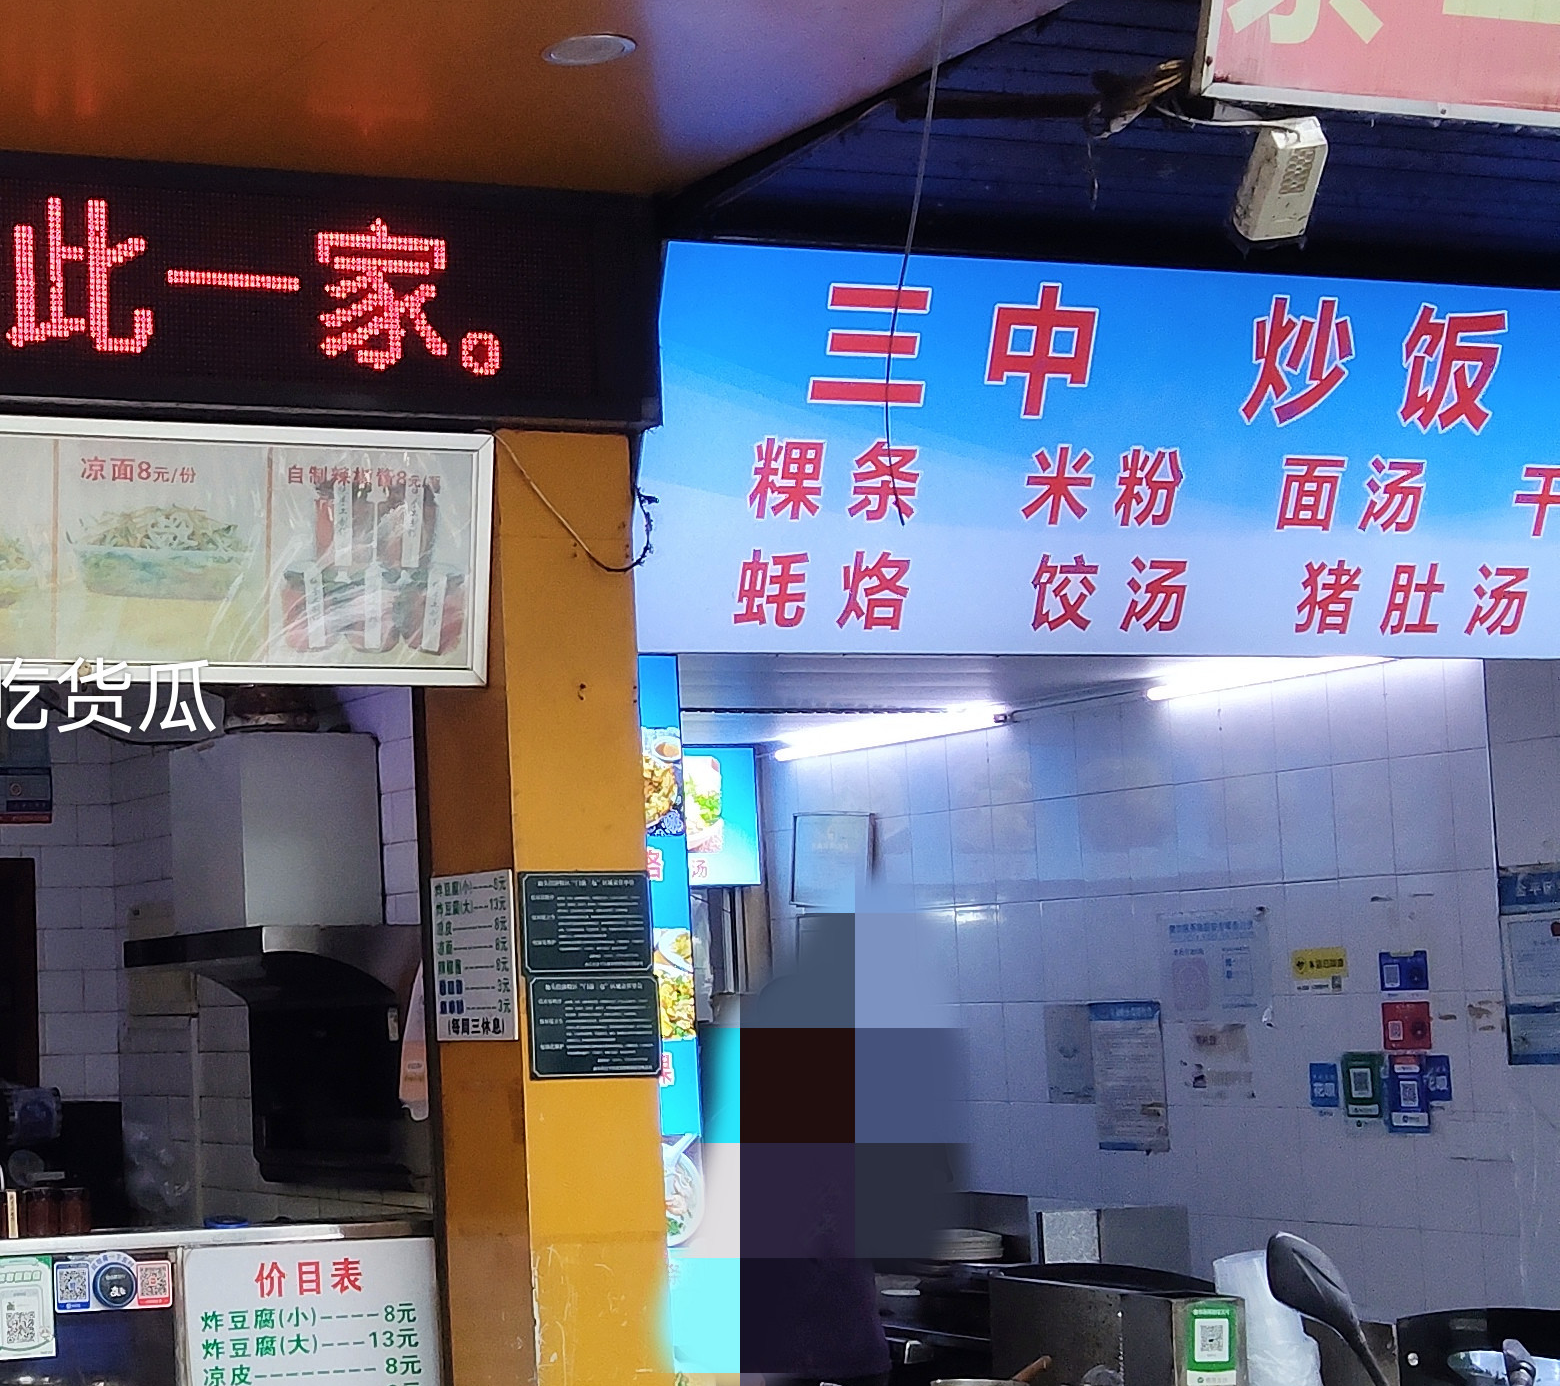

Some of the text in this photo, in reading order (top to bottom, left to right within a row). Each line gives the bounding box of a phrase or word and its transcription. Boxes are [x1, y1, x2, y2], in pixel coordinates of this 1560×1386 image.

[806, 280, 1509, 436] 三中 炒饭
[80, 455, 197, 484] 凉面8元/份
[747, 434, 922, 524] 粿条
[1019, 442, 1185, 527] 米粉
[1274, 453, 1427, 535] 面汤
[731, 548, 1531, 638] 蚝烙 饺汤 猪肚汤
[254, 1257, 363, 1299] 价目表
[200, 1302, 417, 1333] 炸豆腐(小) 8元
[202, 1327, 419, 1360] 炸豆腐(大) 13元
[385, 1355, 422, 1376] 8元
